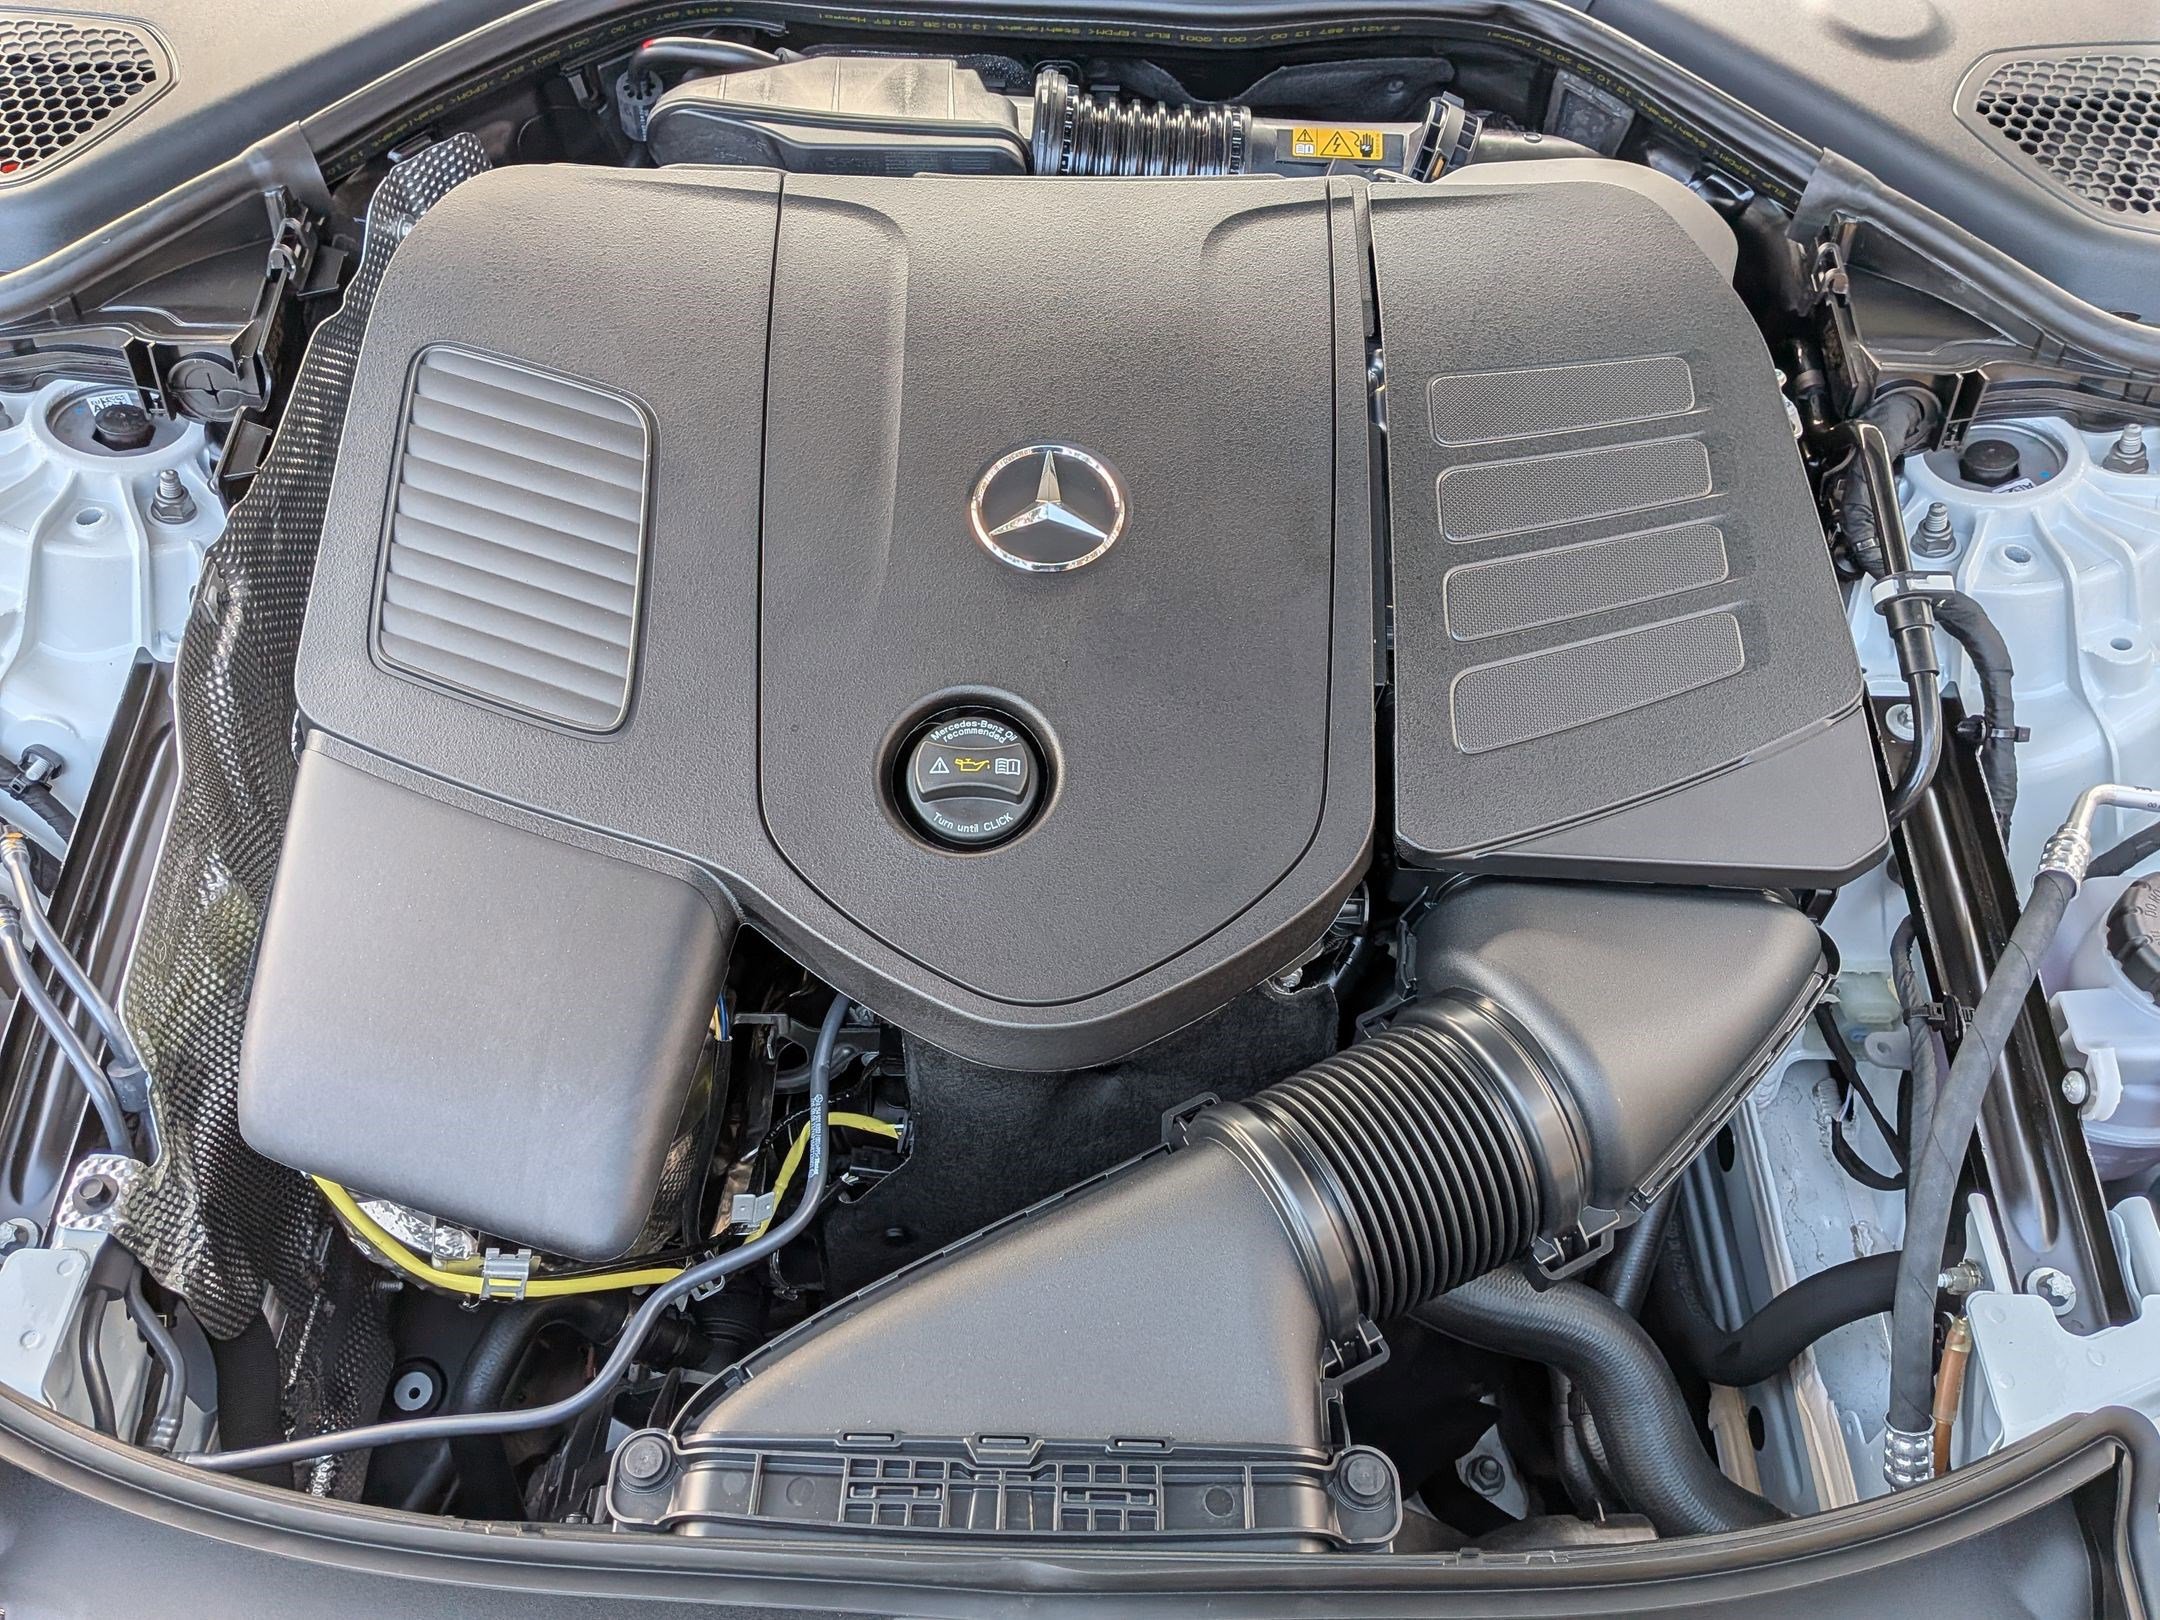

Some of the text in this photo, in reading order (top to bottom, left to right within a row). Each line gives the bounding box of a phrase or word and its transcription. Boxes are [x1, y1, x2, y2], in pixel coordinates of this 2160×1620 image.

[1087, 28, 1137, 38] >EPDM<
[1145, 31, 1171, 39] ELP
[1270, 32, 1288, 40] 00
[1295, 29, 1310, 38] 13
[1221, 35, 1247, 43] 001
[931, 720, 1018, 742] Mercedes-Benz Oil
[943, 728, 1008, 744] recommended
[933, 812, 1014, 833] Turn until CLICK
